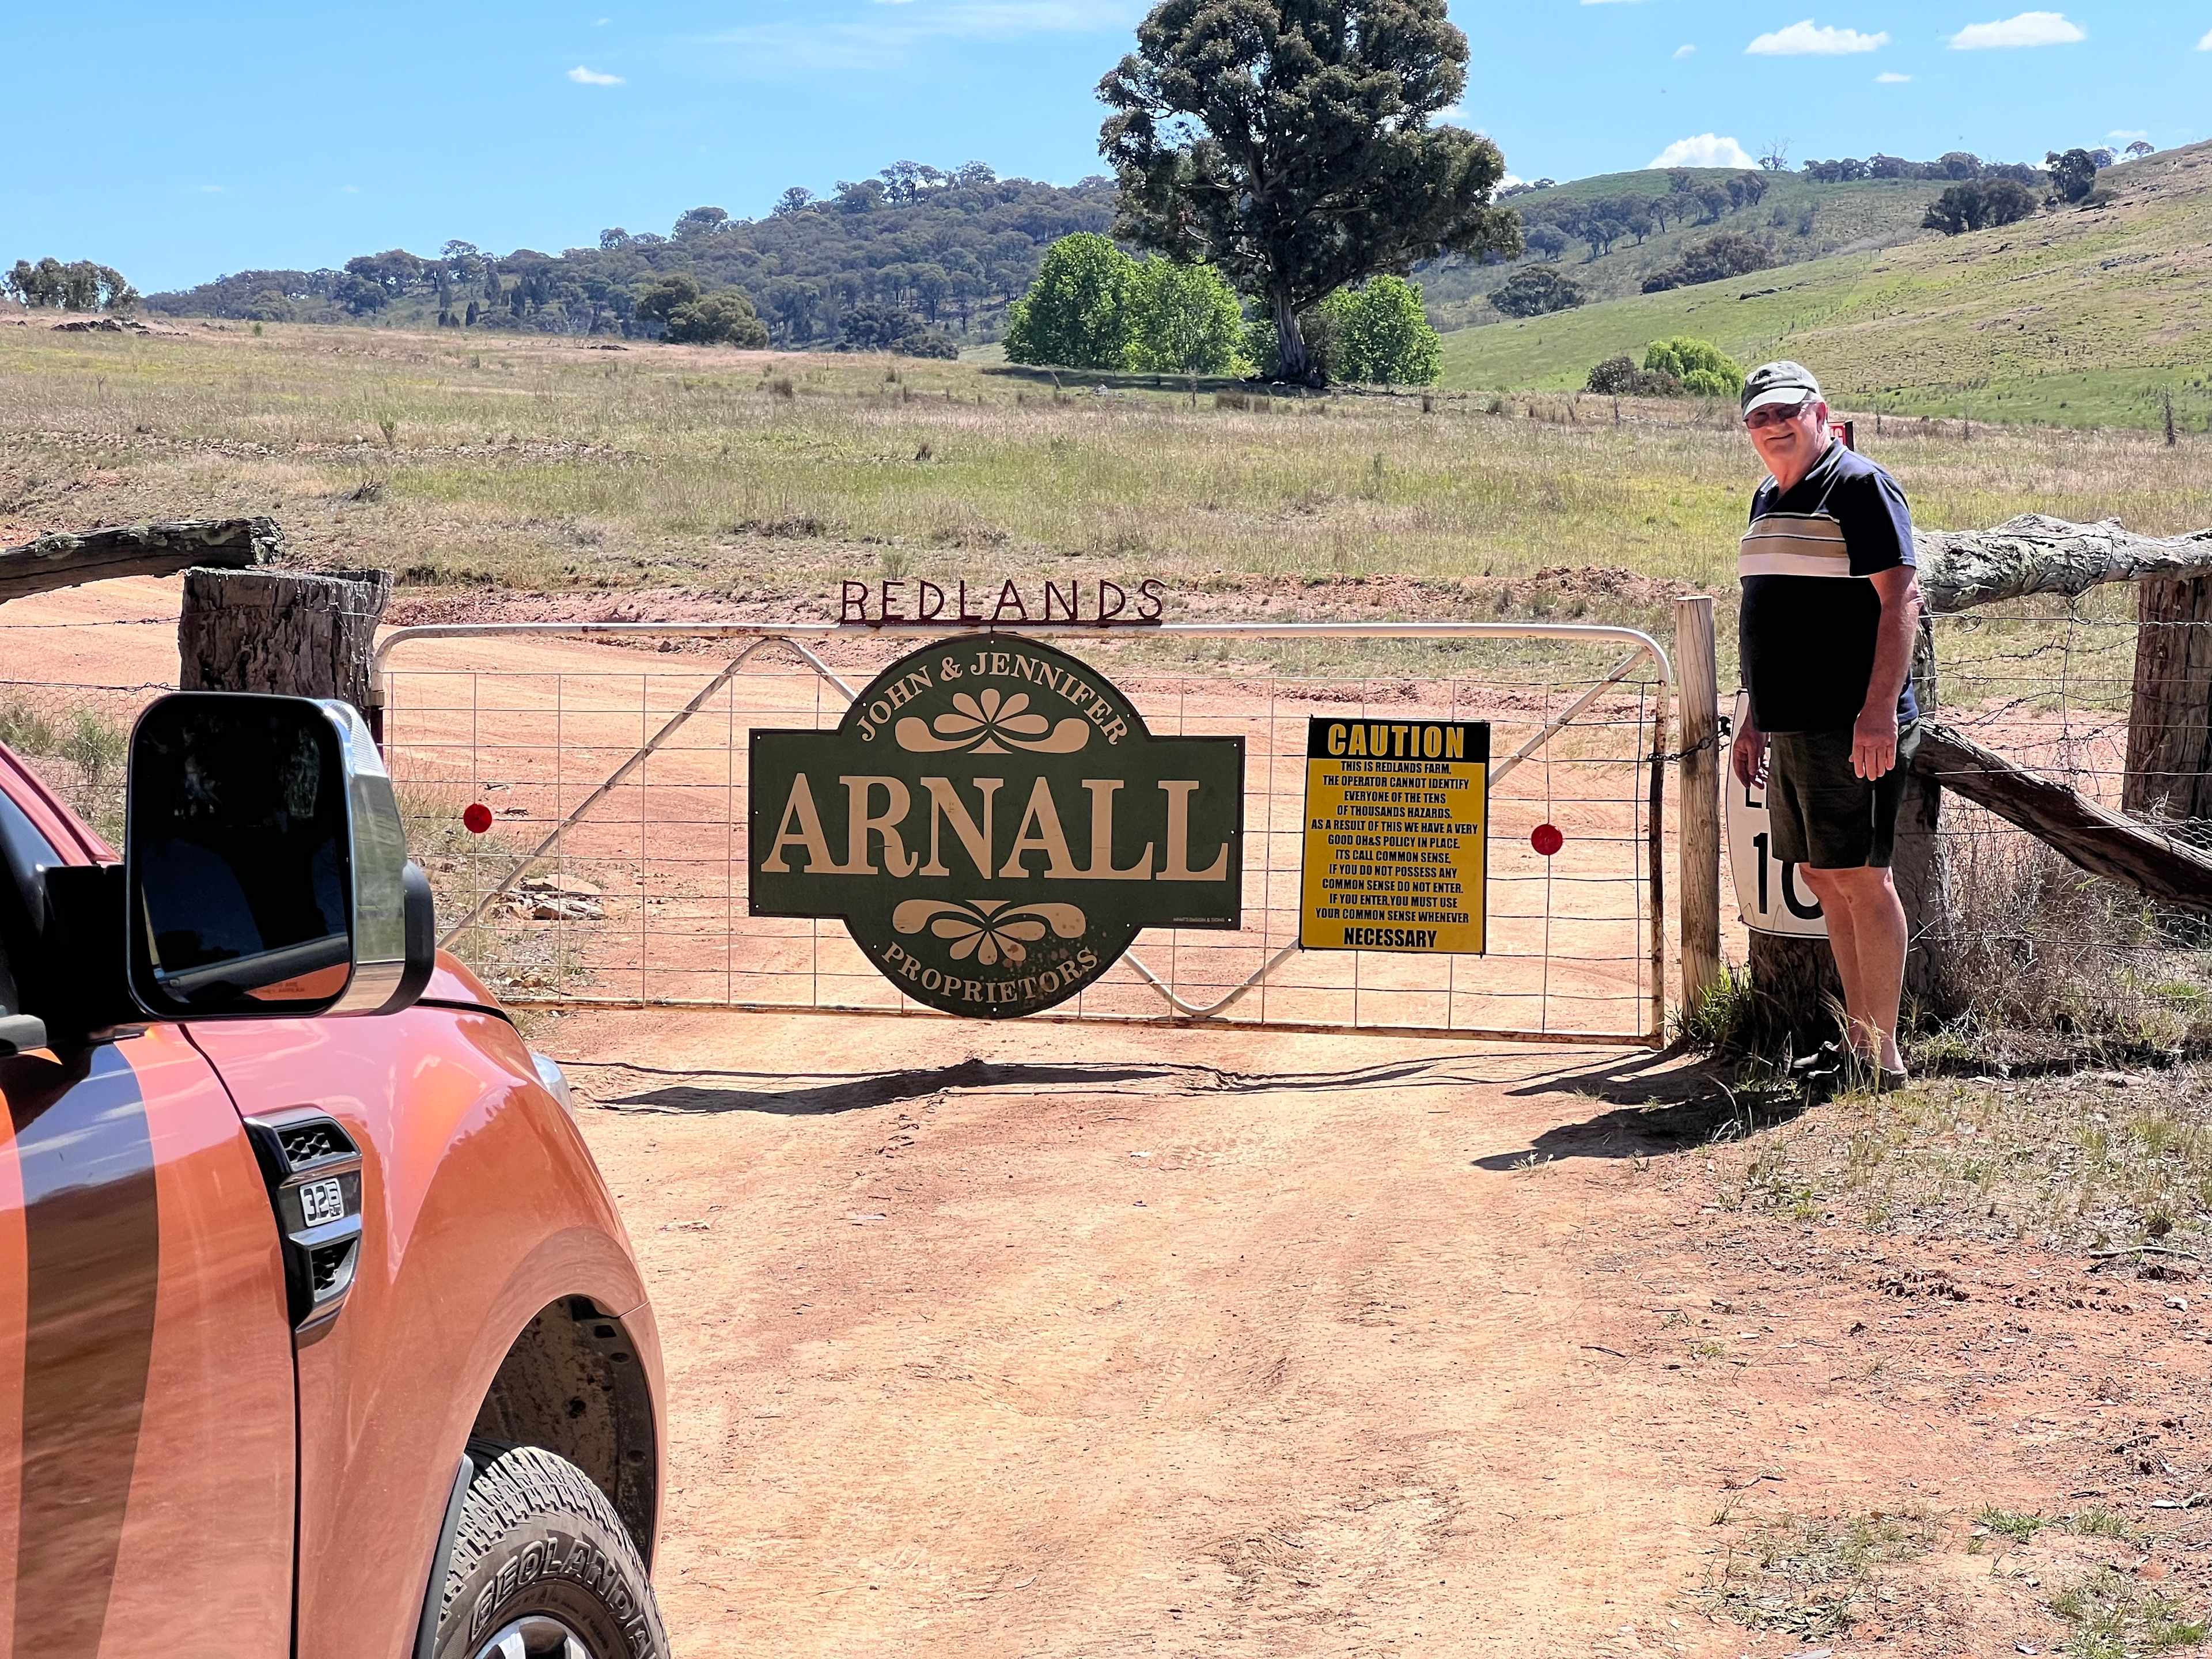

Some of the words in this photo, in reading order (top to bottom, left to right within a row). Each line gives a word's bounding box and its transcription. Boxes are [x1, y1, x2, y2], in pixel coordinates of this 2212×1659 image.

[842, 578, 1166, 621] REDLANDS
[855, 665, 934, 741] JOHN
[940, 657, 963, 682] &
[970, 652, 1128, 745] JENNIFER
[1327, 724, 1464, 758] CAUTION
[1340, 760, 1362, 772] THIS
[1363, 760, 1373, 772] IS
[1375, 761, 1422, 774] REDLANDS
[1323, 775, 1339, 786] THE
[1341, 775, 1387, 788] OPERATOR
[1389, 777, 1427, 789] CANNOT
[1428, 777, 1469, 790] IDENTIFY
[1344, 790, 1389, 802] EVERYONE
[1391, 791, 1403, 802] OF
[1404, 791, 1421, 804] THE
[1423, 792, 1446, 804] TENS
[1337, 804, 1349, 816] OF
[1350, 805, 1406, 818] THOUSANDS
[1407, 806, 1453, 820] HAZARDS.
[760, 772, 1229, 881] ARNALL
[1311, 819, 1323, 830] AS
[1325, 819, 1332, 830] A
[1333, 819, 1366, 831] RESULT
[1368, 820, 1379, 832] OF
[1381, 820, 1402, 832] THIS
[1404, 821, 1419, 833] WE
[1421, 822, 1445, 834] HAVE
[1446, 823, 1453, 834] A
[1455, 823, 1478, 835] VERY
[1328, 834, 1353, 845] GOOD
[1355, 834, 1381, 847] OH&S
[1383, 835, 1416, 847] POLICY
[1418, 836, 1427, 849] IN
[1353, 849, 1374, 861] CALL
[1376, 850, 1419, 863] COMMON
[1329, 863, 1338, 874] IF
[1339, 863, 1357, 876] YOU
[1359, 864, 1373, 876] DO
[1374, 865, 1393, 877] NOT
[1395, 865, 1437, 878] POSSESS
[1438, 867, 1457, 879] ANY
[1322, 878, 1365, 891] COMMON
[1366, 879, 1395, 892] SENSE
[1397, 880, 1410, 892] DO
[1412, 881, 1431, 893] NOT
[1330, 892, 1338, 904] IF
[1339, 893, 1358, 906] YOU
[1411, 896, 1438, 908] MUST
[1440, 896, 1457, 909] USE
[1316, 907, 1340, 919] YOUR
[1342, 908, 1385, 921] COMMON
[1387, 910, 1416, 922] SENSE
[1418, 911, 1469, 924] WHENEVER
[1343, 926, 1437, 949] NECESSARY
[881, 941, 1097, 1003] PROPRIETORS
[471, 1536, 657, 1659] GEOLANDA
